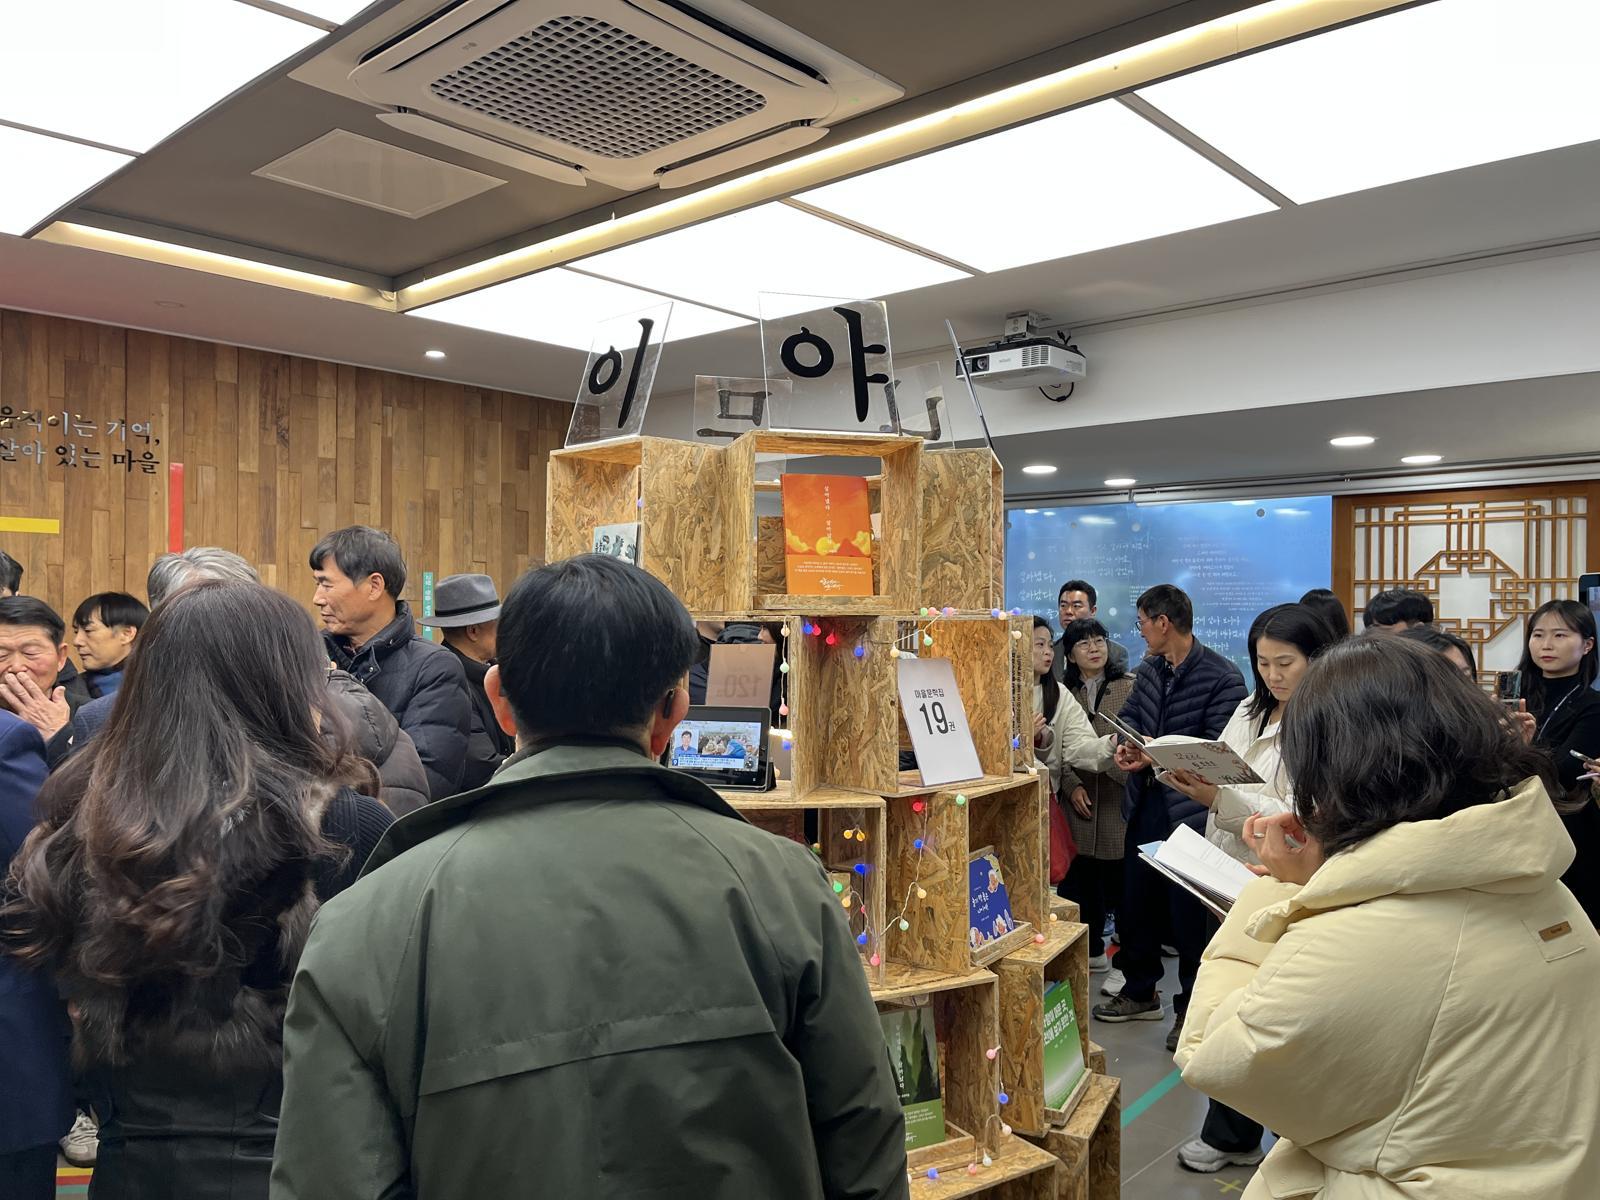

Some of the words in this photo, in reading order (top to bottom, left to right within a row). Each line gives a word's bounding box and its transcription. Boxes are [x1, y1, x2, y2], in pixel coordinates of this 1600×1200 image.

[588, 318, 654, 430] 이
[779, 306, 889, 423] 야
[0, 405, 98, 437] 움직이는
[106, 418, 160, 446] 기억,
[55, 442, 104, 469] 있는
[112, 449, 160, 474] 마을
[914, 688, 945, 699] 마을문학집
